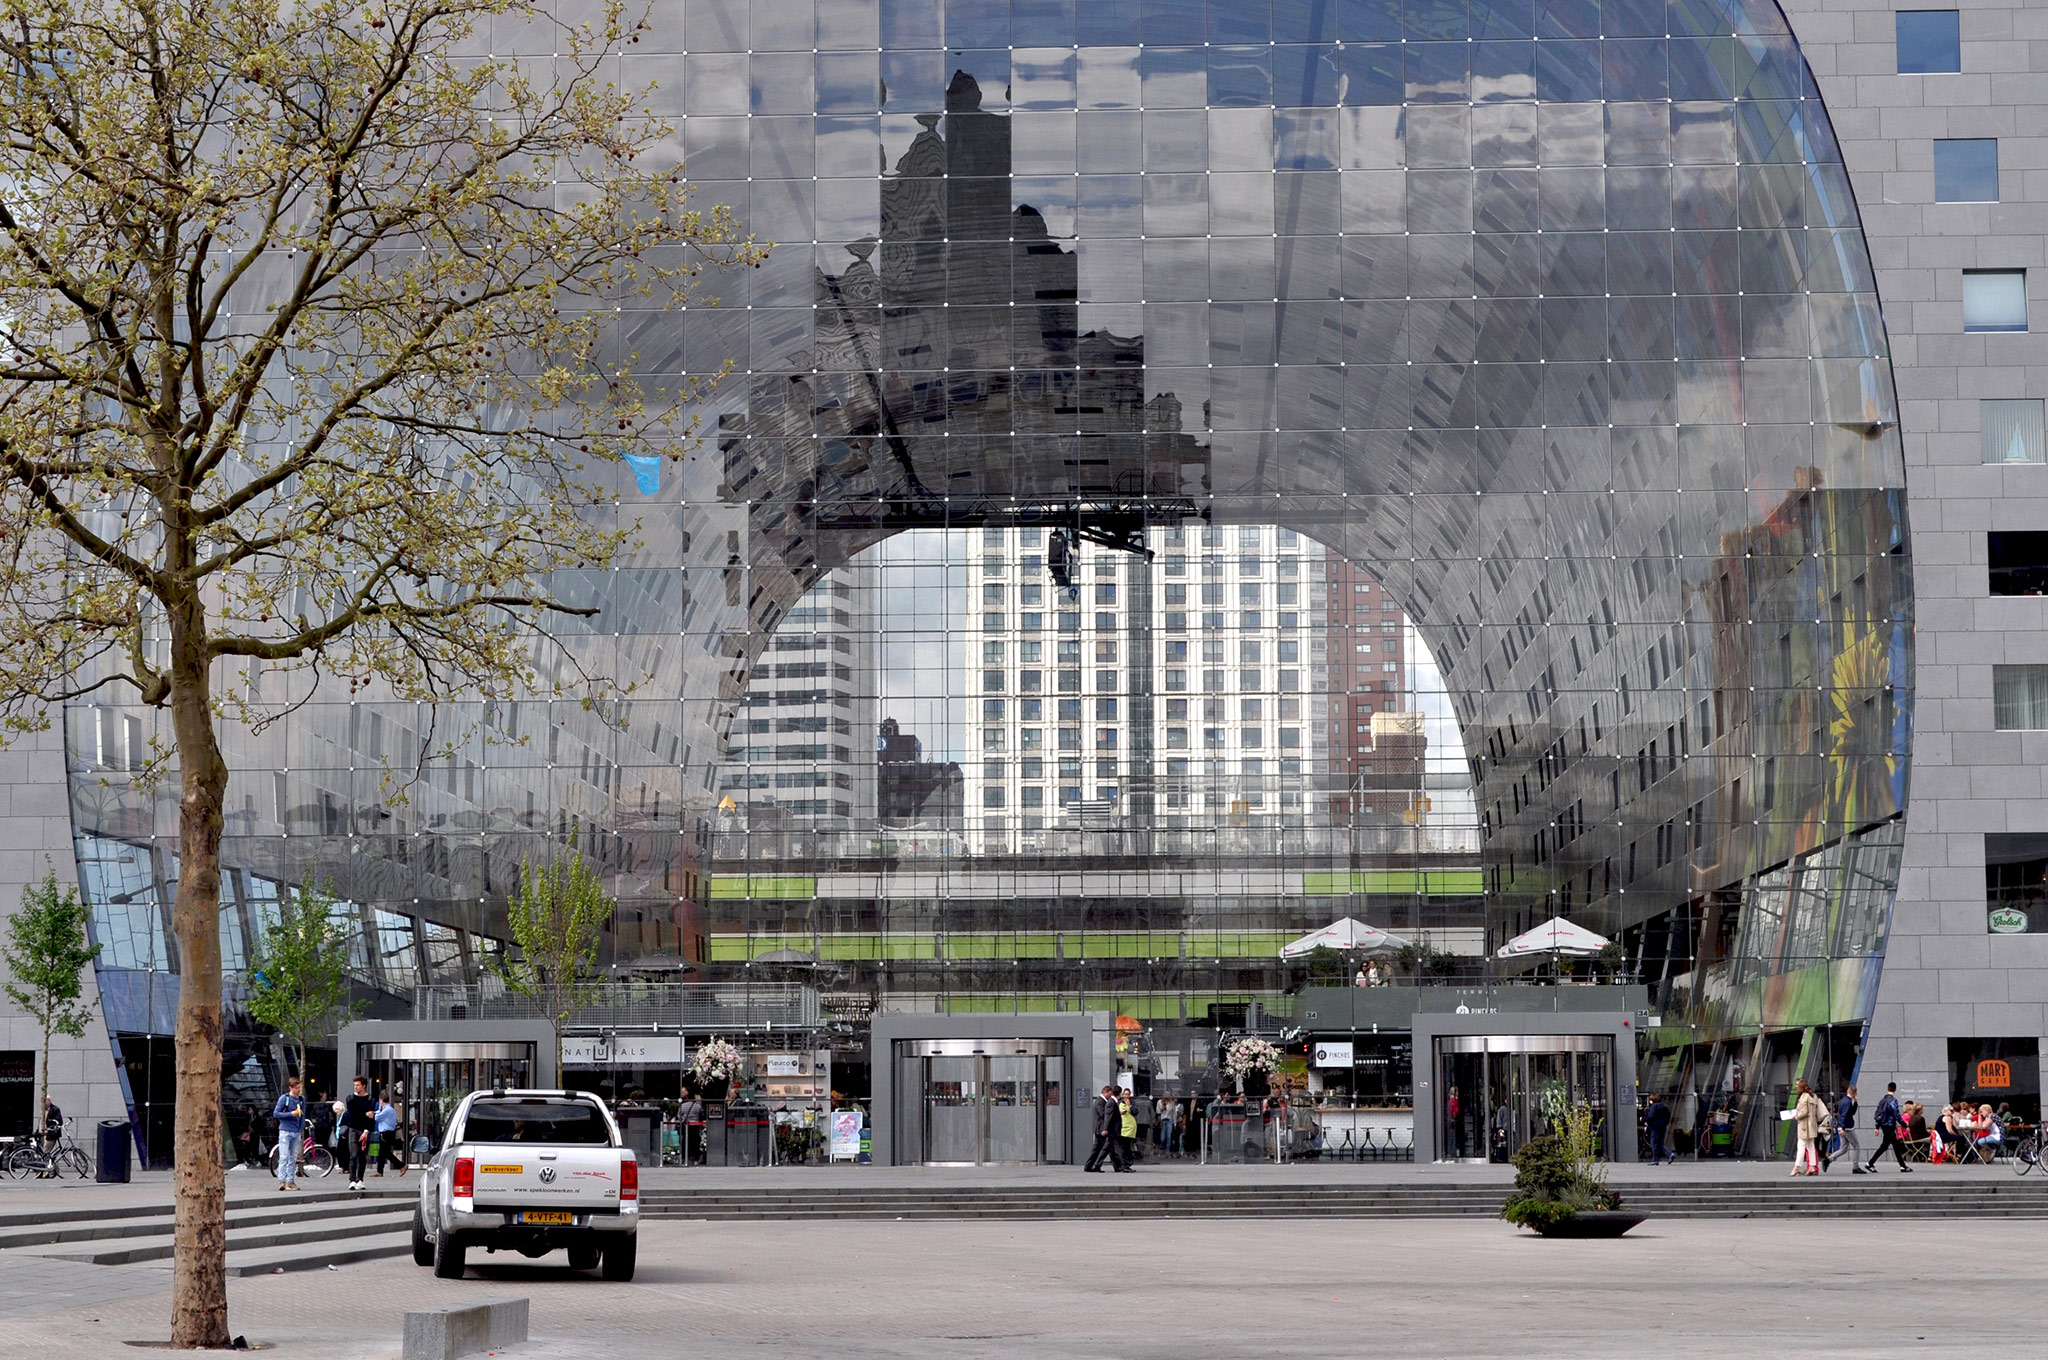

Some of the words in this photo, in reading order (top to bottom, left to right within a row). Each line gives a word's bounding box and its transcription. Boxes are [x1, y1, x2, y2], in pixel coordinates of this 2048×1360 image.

[1992, 915, 2023, 927] Grolsch
[564, 1048, 645, 1056] NATURALS
[1328, 1051, 1350, 1059] PINCHOS
[1981, 1063, 2006, 1076] MART
[528, 1213, 567, 1221] 4-VTF-41
